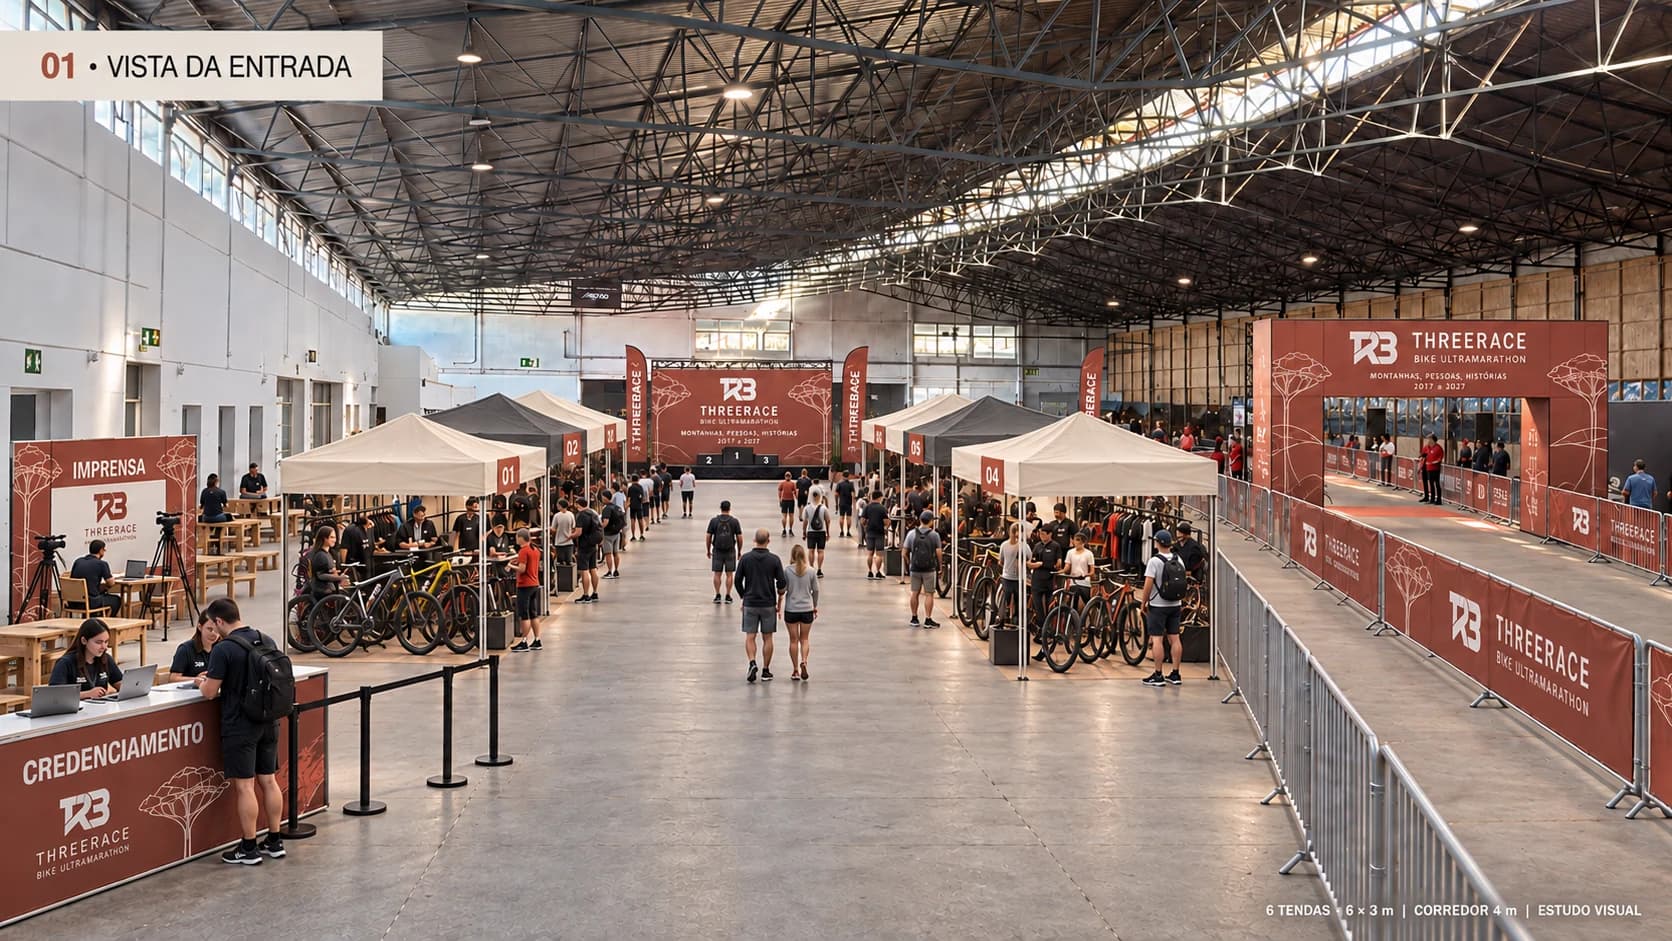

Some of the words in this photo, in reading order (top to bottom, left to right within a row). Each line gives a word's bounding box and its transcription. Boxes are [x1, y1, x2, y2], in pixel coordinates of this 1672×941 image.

[1411, 332, 1527, 350] THREERACE
[1414, 355, 1437, 364] BIKE
[1440, 355, 1527, 364] ULTRAMARATHON
[700, 405, 779, 417] THREERACE
[566, 440, 579, 457] 02
[735, 451, 740, 460] 1
[72, 458, 146, 480] IMPRENSA
[705, 456, 713, 464] 2
[763, 456, 769, 464] 3
[502, 465, 515, 486] 01
[986, 466, 999, 487] 04
[84, 523, 137, 538] THREERACE
[1496, 614, 1590, 690] THREERACE
[1496, 650, 1513, 671] BIKE
[1515, 660, 1590, 717] ULTRAMARATHON
[22, 721, 204, 786] CREDENCIAMENTO
[35, 826, 130, 866] THREERACE
[36, 866, 57, 880] BIKE
[59, 843, 130, 873] ULTRAMARATHON
